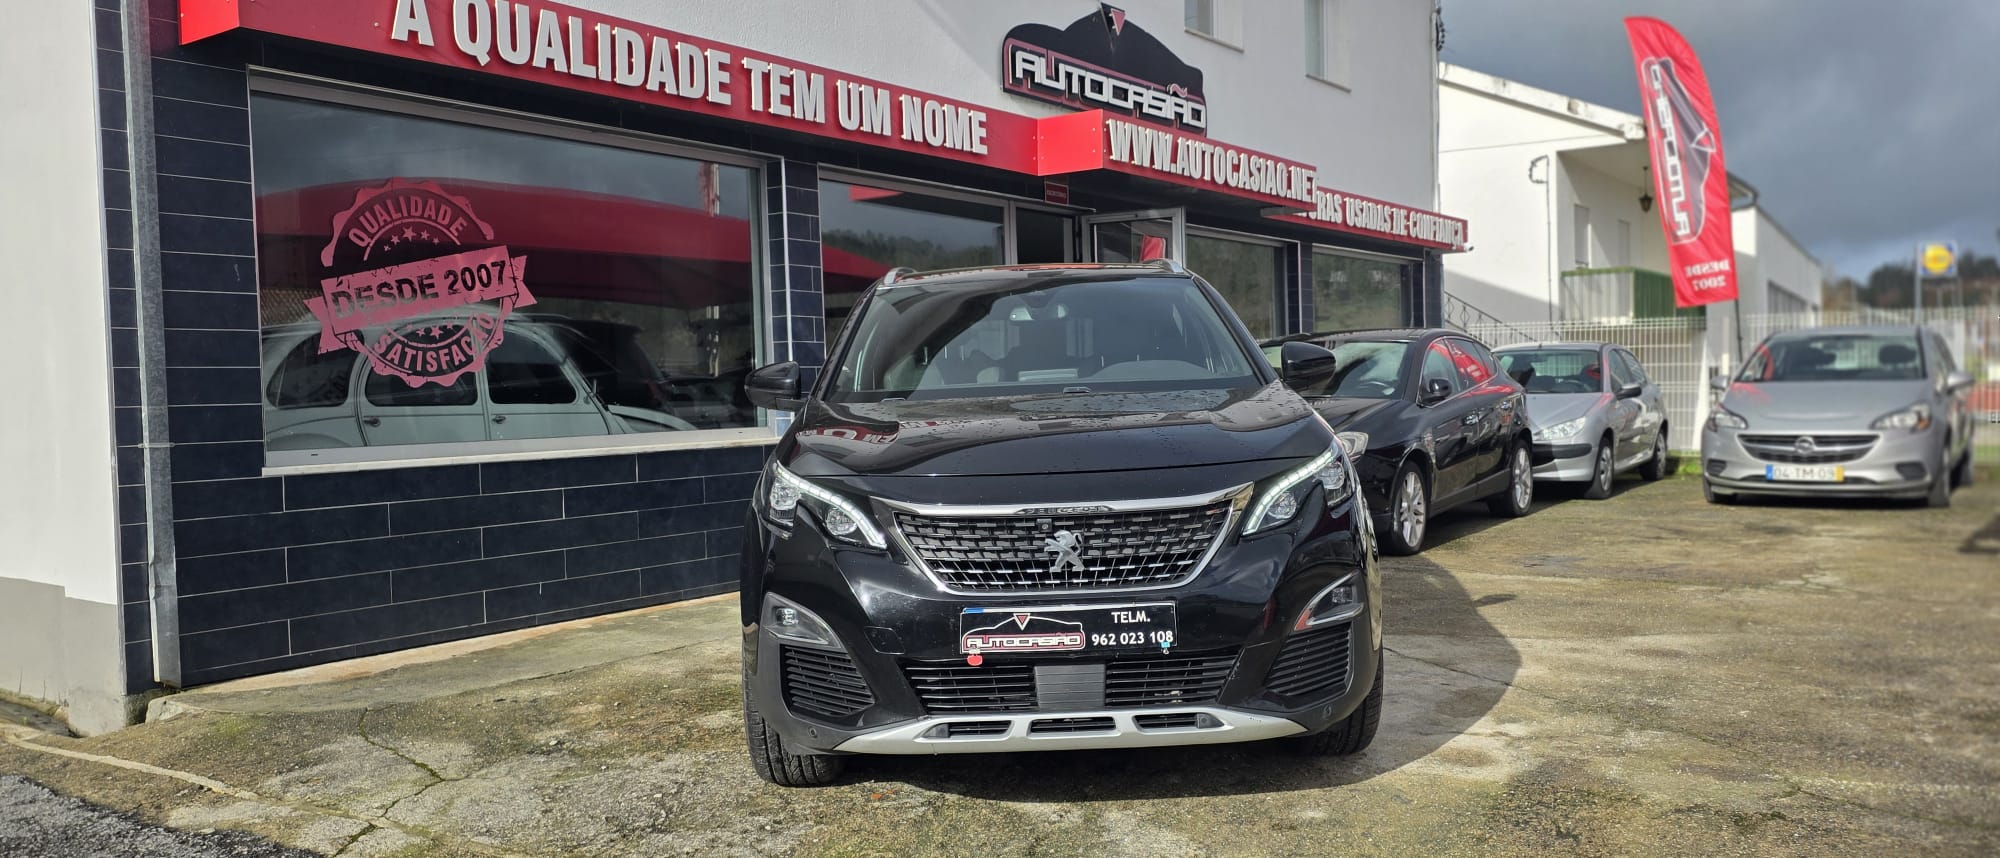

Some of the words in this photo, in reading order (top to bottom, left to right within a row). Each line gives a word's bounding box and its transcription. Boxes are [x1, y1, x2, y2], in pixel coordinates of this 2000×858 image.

[391, 0, 434, 46] A
[453, 0, 732, 105] QUALIDADE
[742, 57, 826, 124] TEM
[836, 79, 892, 137] UM
[900, 93, 988, 155] NOME
[349, 195, 468, 248] QUALIDADE
[1344, 197, 1392, 234] USADAS
[1408, 210, 1465, 250] CONFIANÇA
[331, 273, 439, 319] DESDE
[444, 260, 507, 295] 2007
[1092, 633, 1117, 646] 962
[1120, 633, 1145, 645] 023
[1150, 630, 1174, 644] 108
[1111, 611, 1151, 624] TELM.
